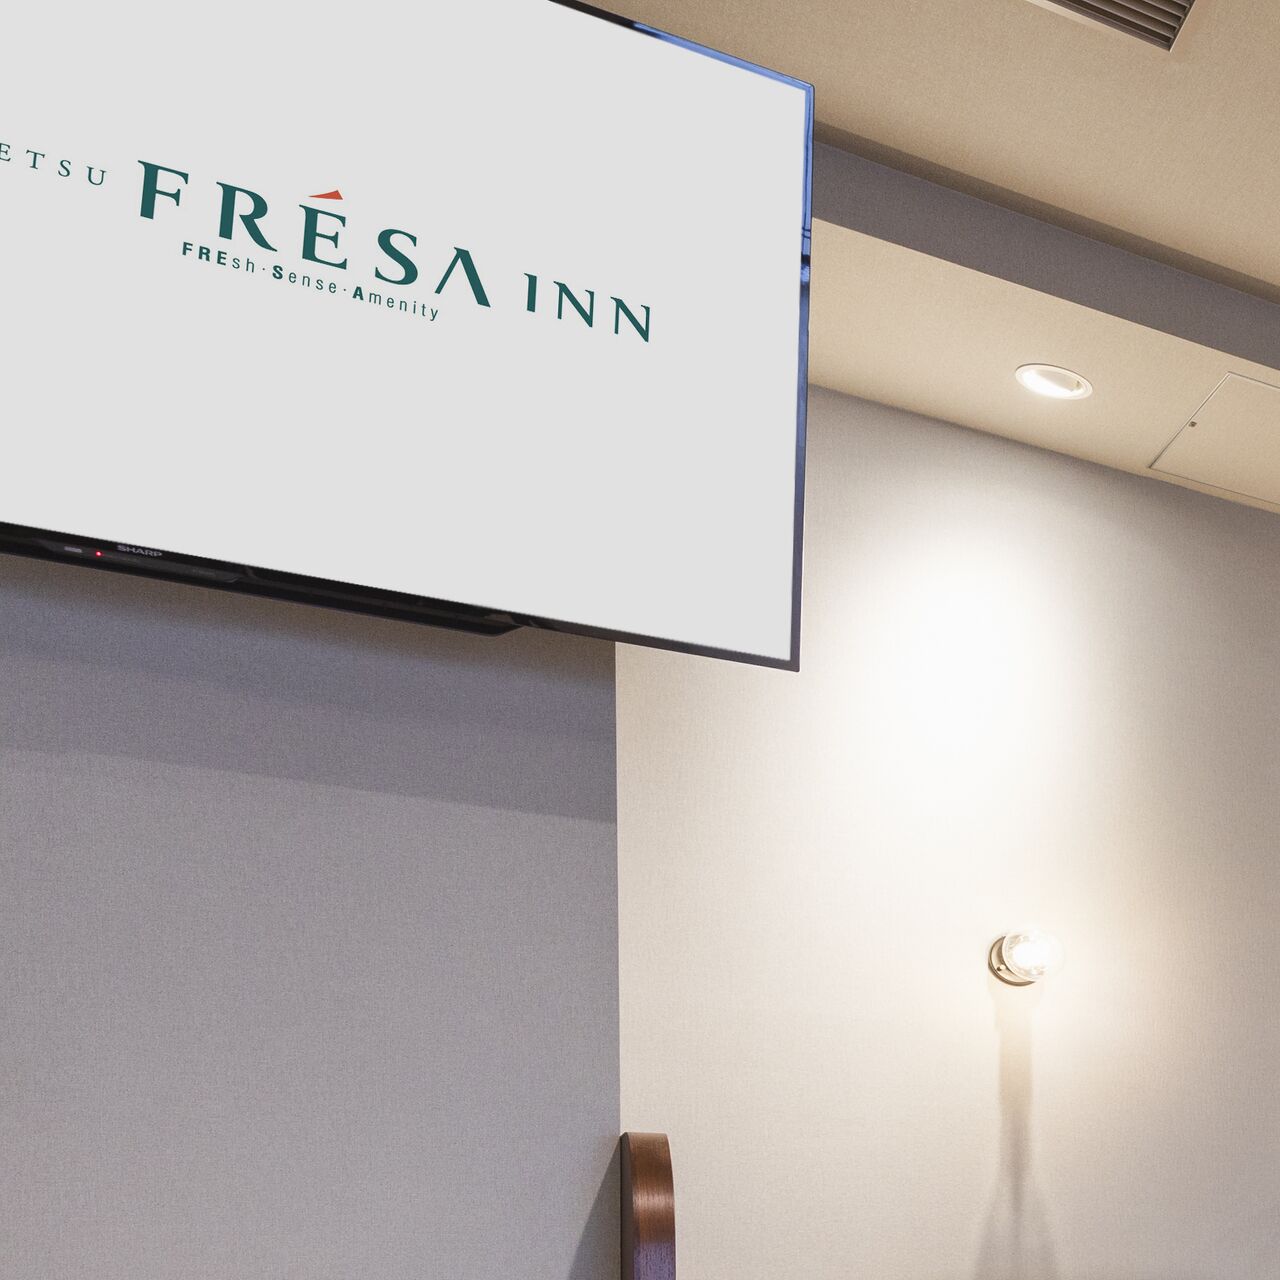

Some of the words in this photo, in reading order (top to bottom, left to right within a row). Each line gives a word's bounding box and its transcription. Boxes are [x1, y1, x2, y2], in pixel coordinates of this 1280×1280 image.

[138, 160, 491, 309] FRÉSA
[524, 272, 652, 343] INN
[117, 544, 163, 557] SHARP
